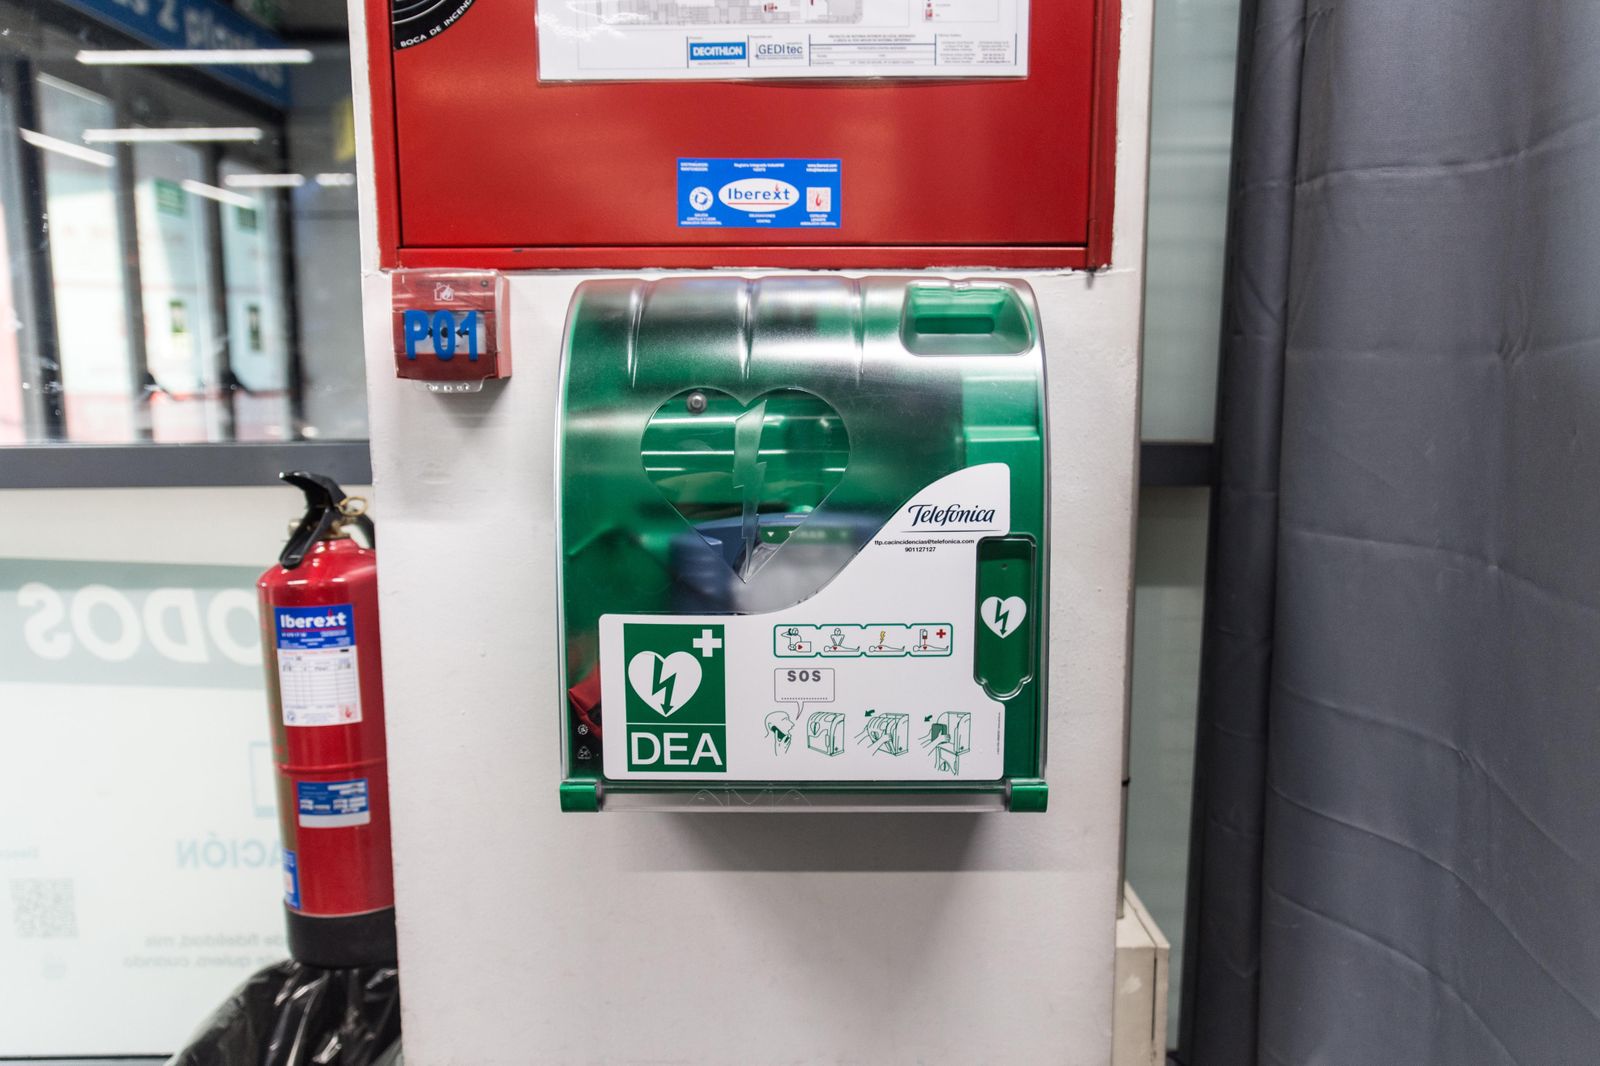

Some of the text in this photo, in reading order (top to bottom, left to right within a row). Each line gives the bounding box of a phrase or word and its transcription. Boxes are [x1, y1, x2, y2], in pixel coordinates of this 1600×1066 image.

[400, 34, 427, 47] BOCA
[429, 25, 442, 36] DE
[692, 46, 743, 57] DECATHLON
[728, 186, 790, 200] Iberext
[404, 309, 478, 361] P01
[280, 612, 347, 629] Iberext
[787, 670, 822, 682] SOS
[631, 731, 723, 766] DEA
